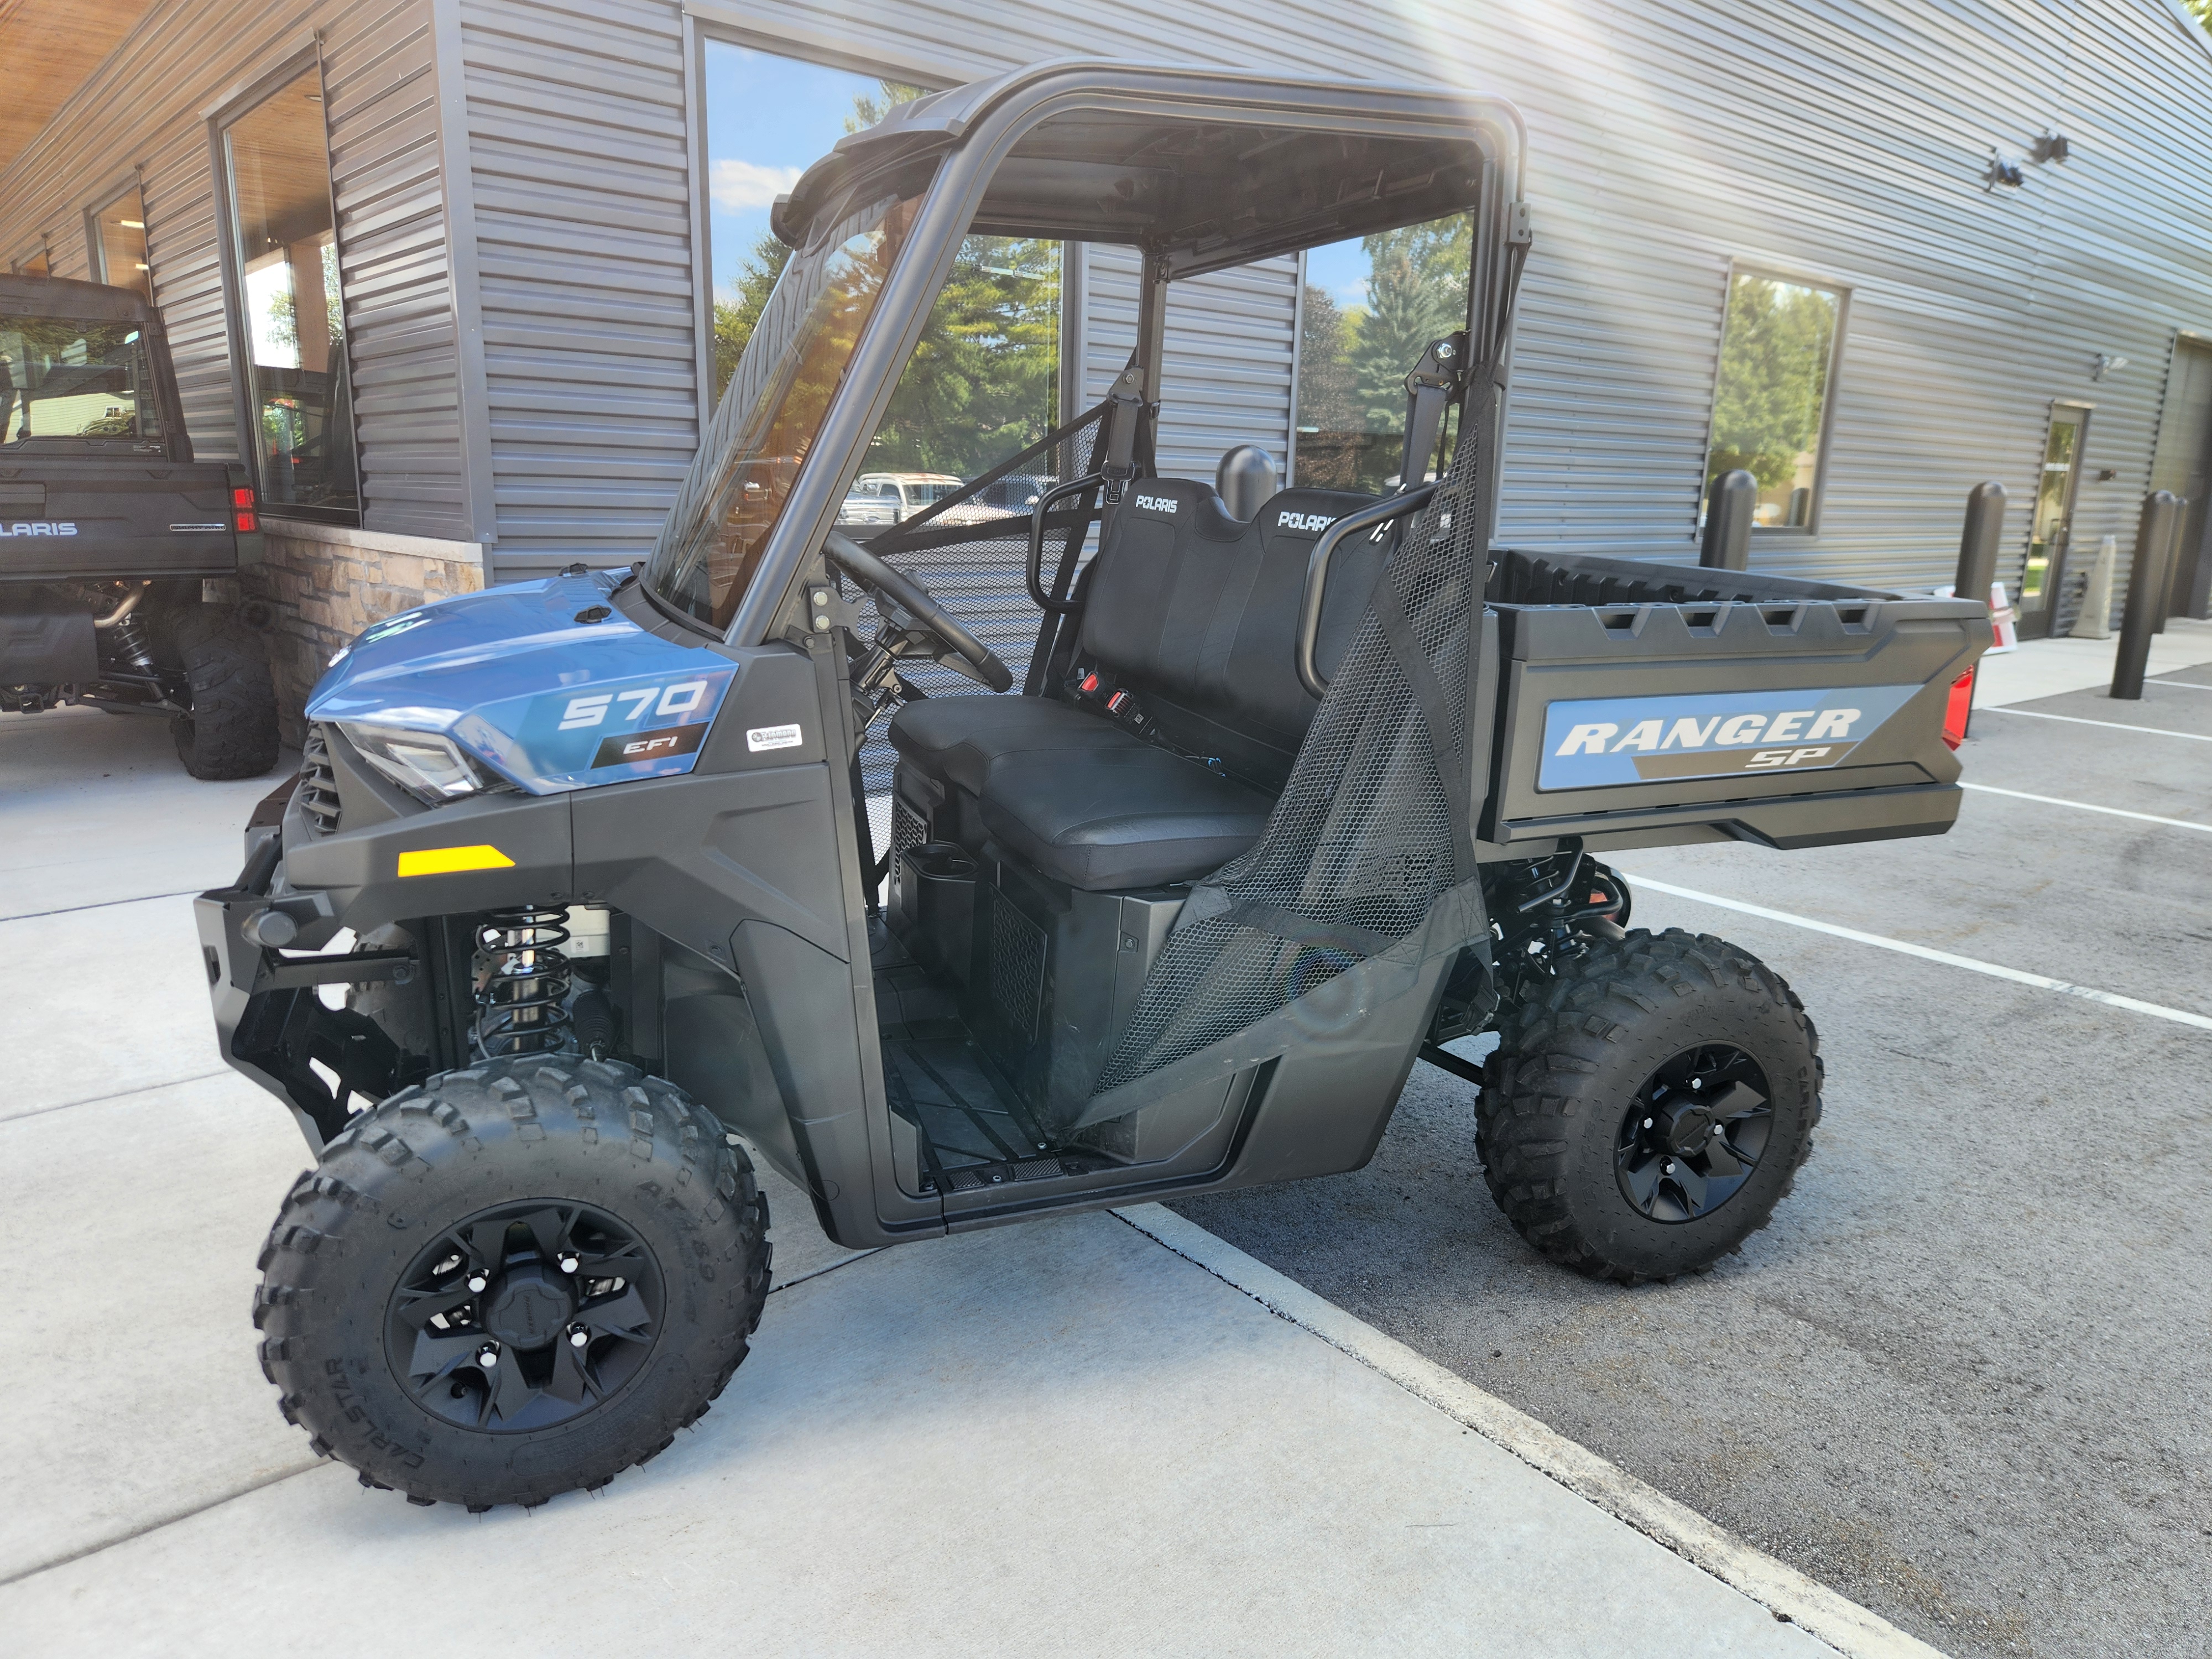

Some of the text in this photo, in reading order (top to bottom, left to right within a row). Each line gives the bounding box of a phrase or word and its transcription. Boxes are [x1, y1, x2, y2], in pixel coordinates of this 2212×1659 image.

[1135, 495, 1178, 513] POLARIS
[557, 680, 708, 731] 570
[1554, 708, 1861, 756] RANGER
[623, 736, 678, 754] EFI
[1745, 747, 1831, 768] SP
